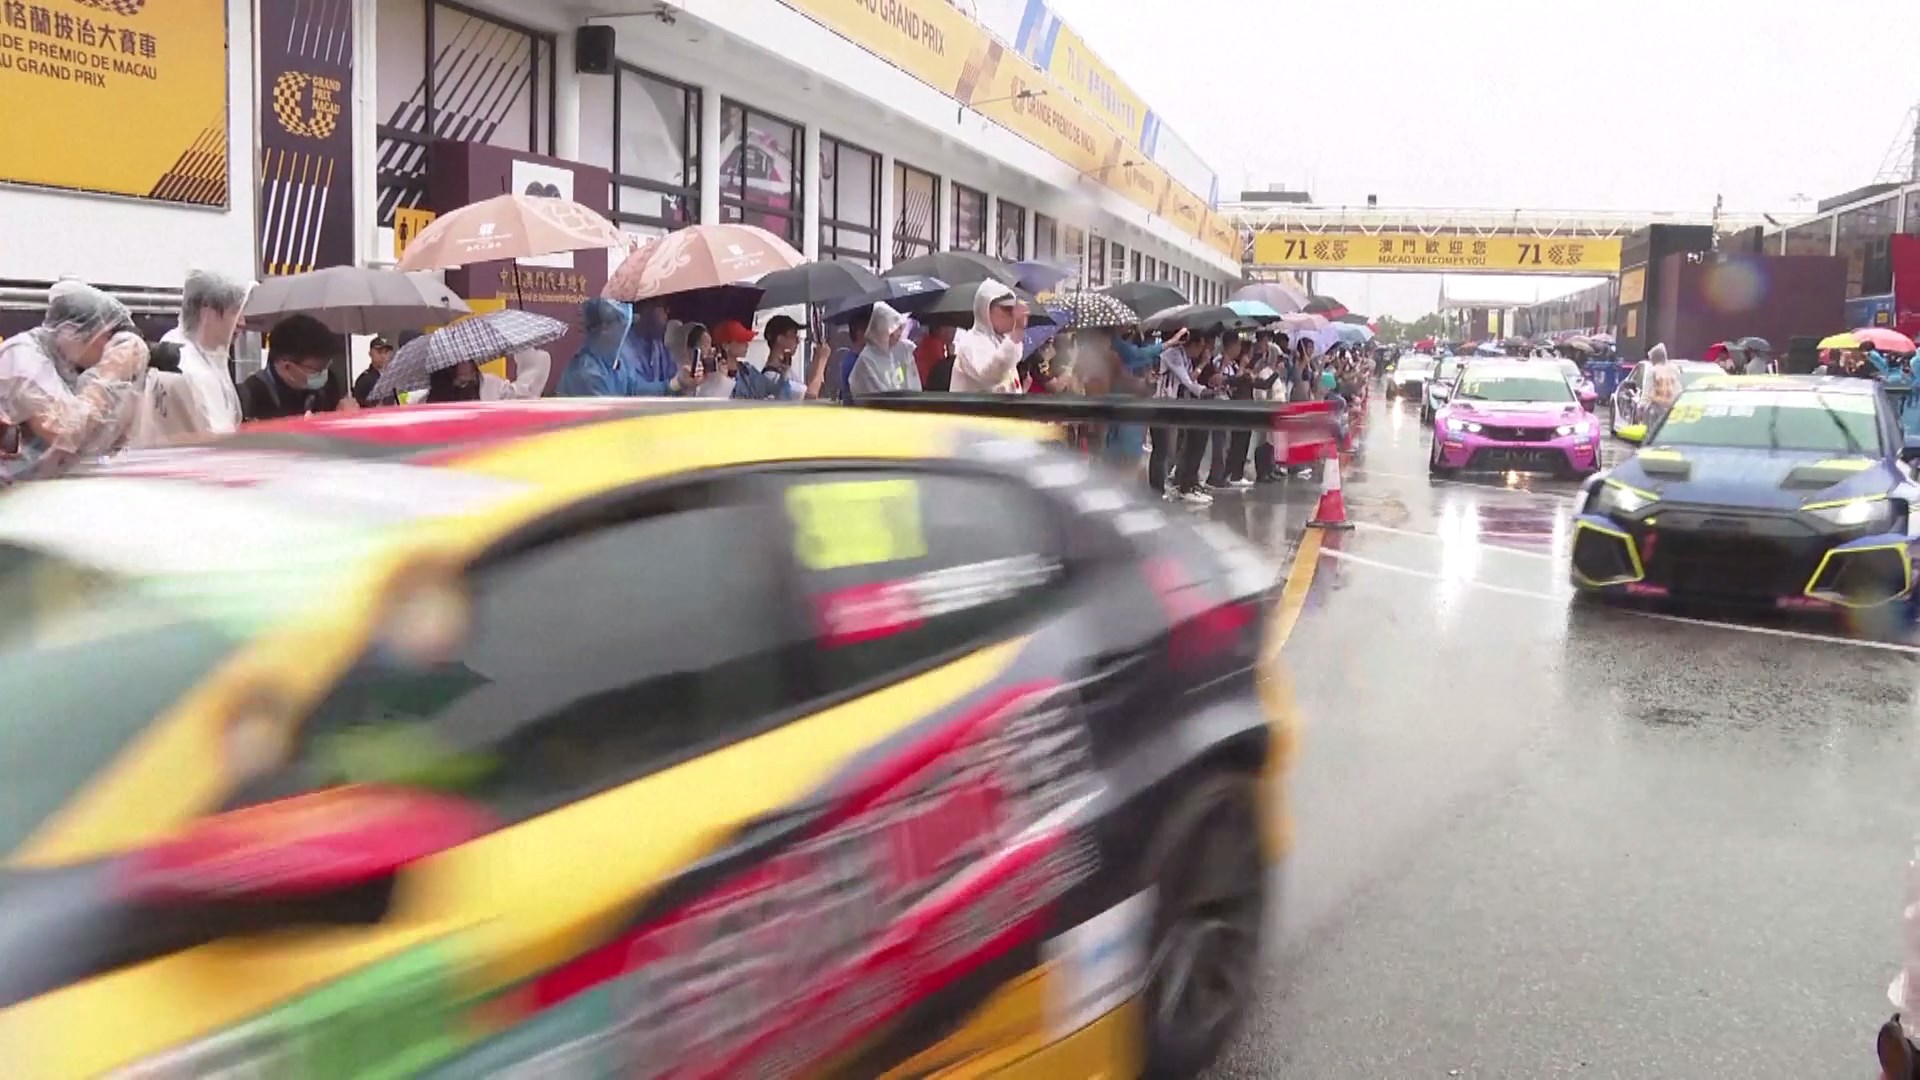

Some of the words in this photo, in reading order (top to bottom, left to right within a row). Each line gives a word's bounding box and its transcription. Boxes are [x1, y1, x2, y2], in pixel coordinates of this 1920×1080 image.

[0, 0, 157, 59] 格蘭披治大賽車
[880, 0, 920, 40] GRAND
[921, 20, 945, 57] PRIX
[16, 57, 71, 81] GRAND
[74, 69, 107, 88] PRIX
[91, 54, 110, 71] DE
[113, 59, 158, 80] MACAU
[312, 87, 332, 101] PRIX
[313, 76, 341, 91] GRAND
[312, 99, 341, 115] MACAU
[1284, 239, 1308, 260] 71
[1378, 239, 1487, 255] 澳門歡迎您
[1517, 243, 1542, 264] 71
[1378, 255, 1411, 265] MACAO
[1413, 256, 1465, 265] WELCOMES
[1467, 257, 1486, 266] YOU
